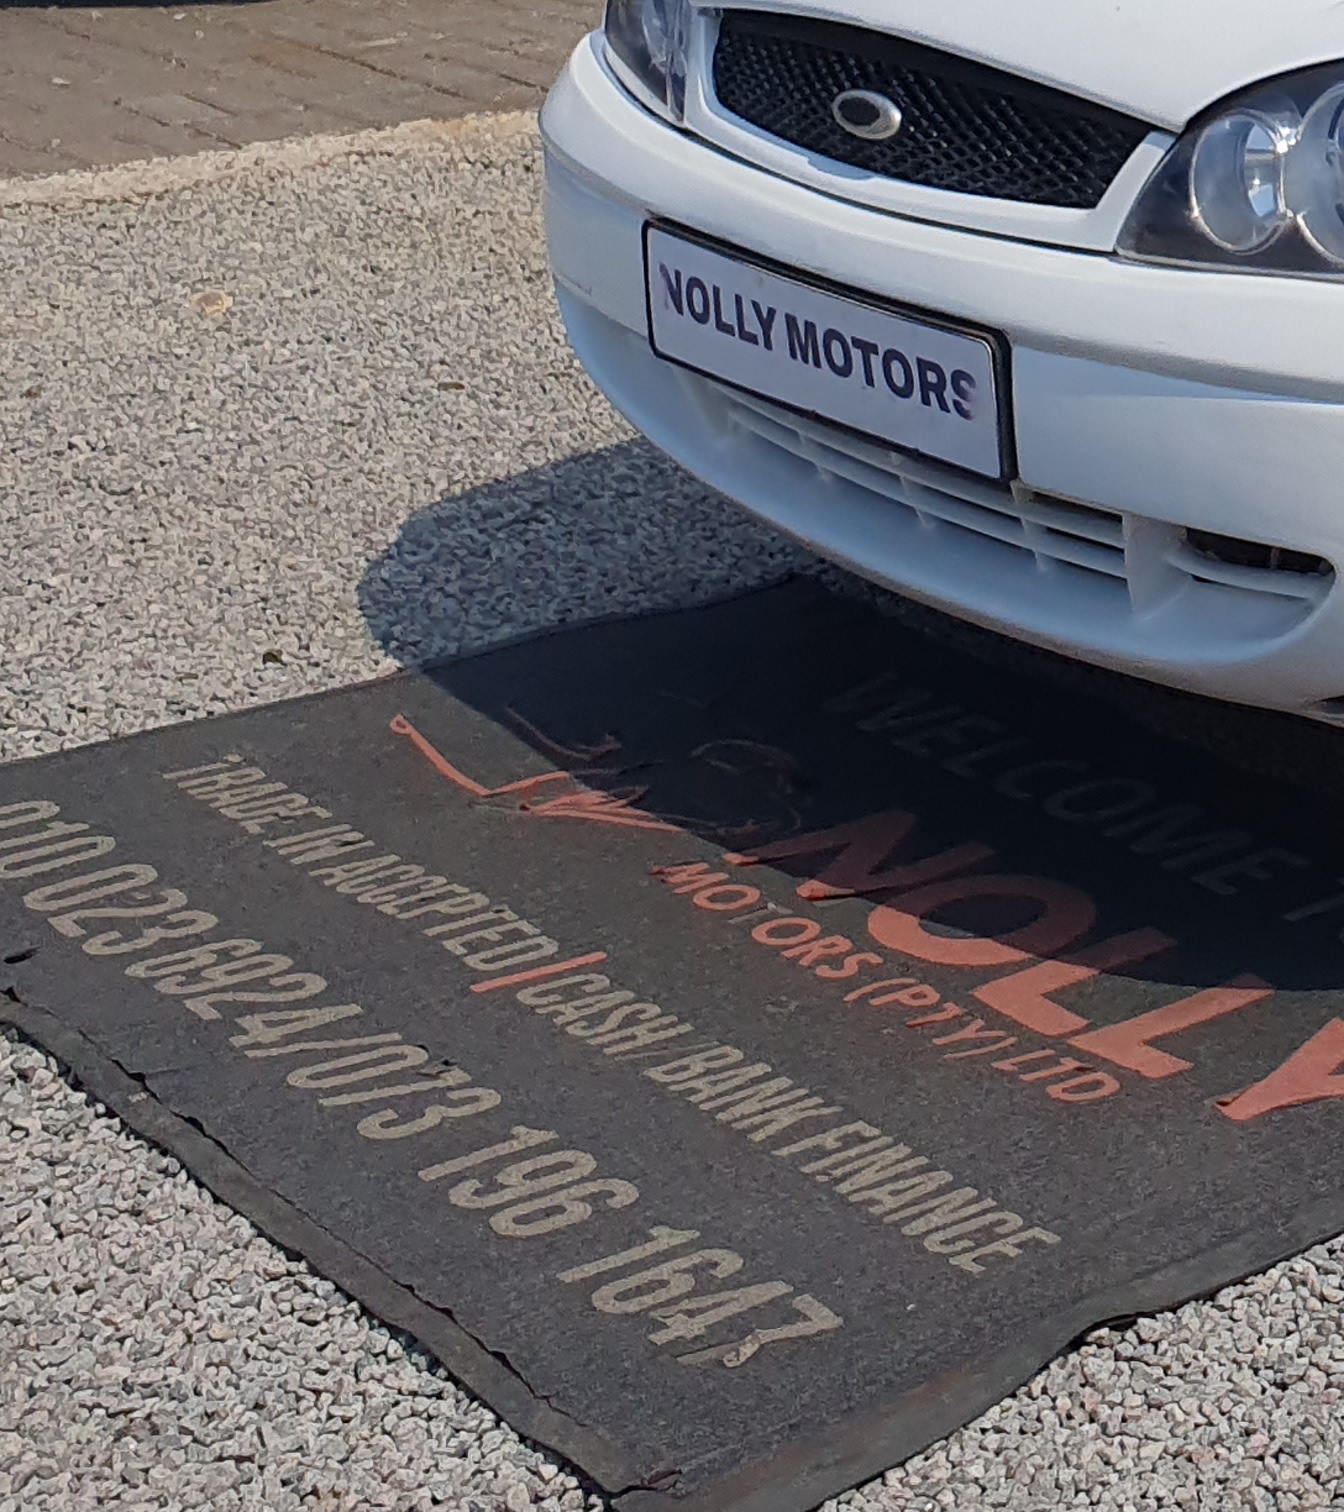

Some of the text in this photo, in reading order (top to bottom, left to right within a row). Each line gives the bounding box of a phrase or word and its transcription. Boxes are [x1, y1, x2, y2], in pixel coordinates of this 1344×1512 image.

[658, 262, 978, 422] NOLLY MOTORS
[821, 669, 1311, 898] WELCOME
[650, 861, 884, 978] MOTORS
[263, 824, 375, 865] IN
[770, 1119, 1062, 1273] FINANCE
[416, 1124, 640, 1238] 196
[555, 1224, 844, 1369] 1647
